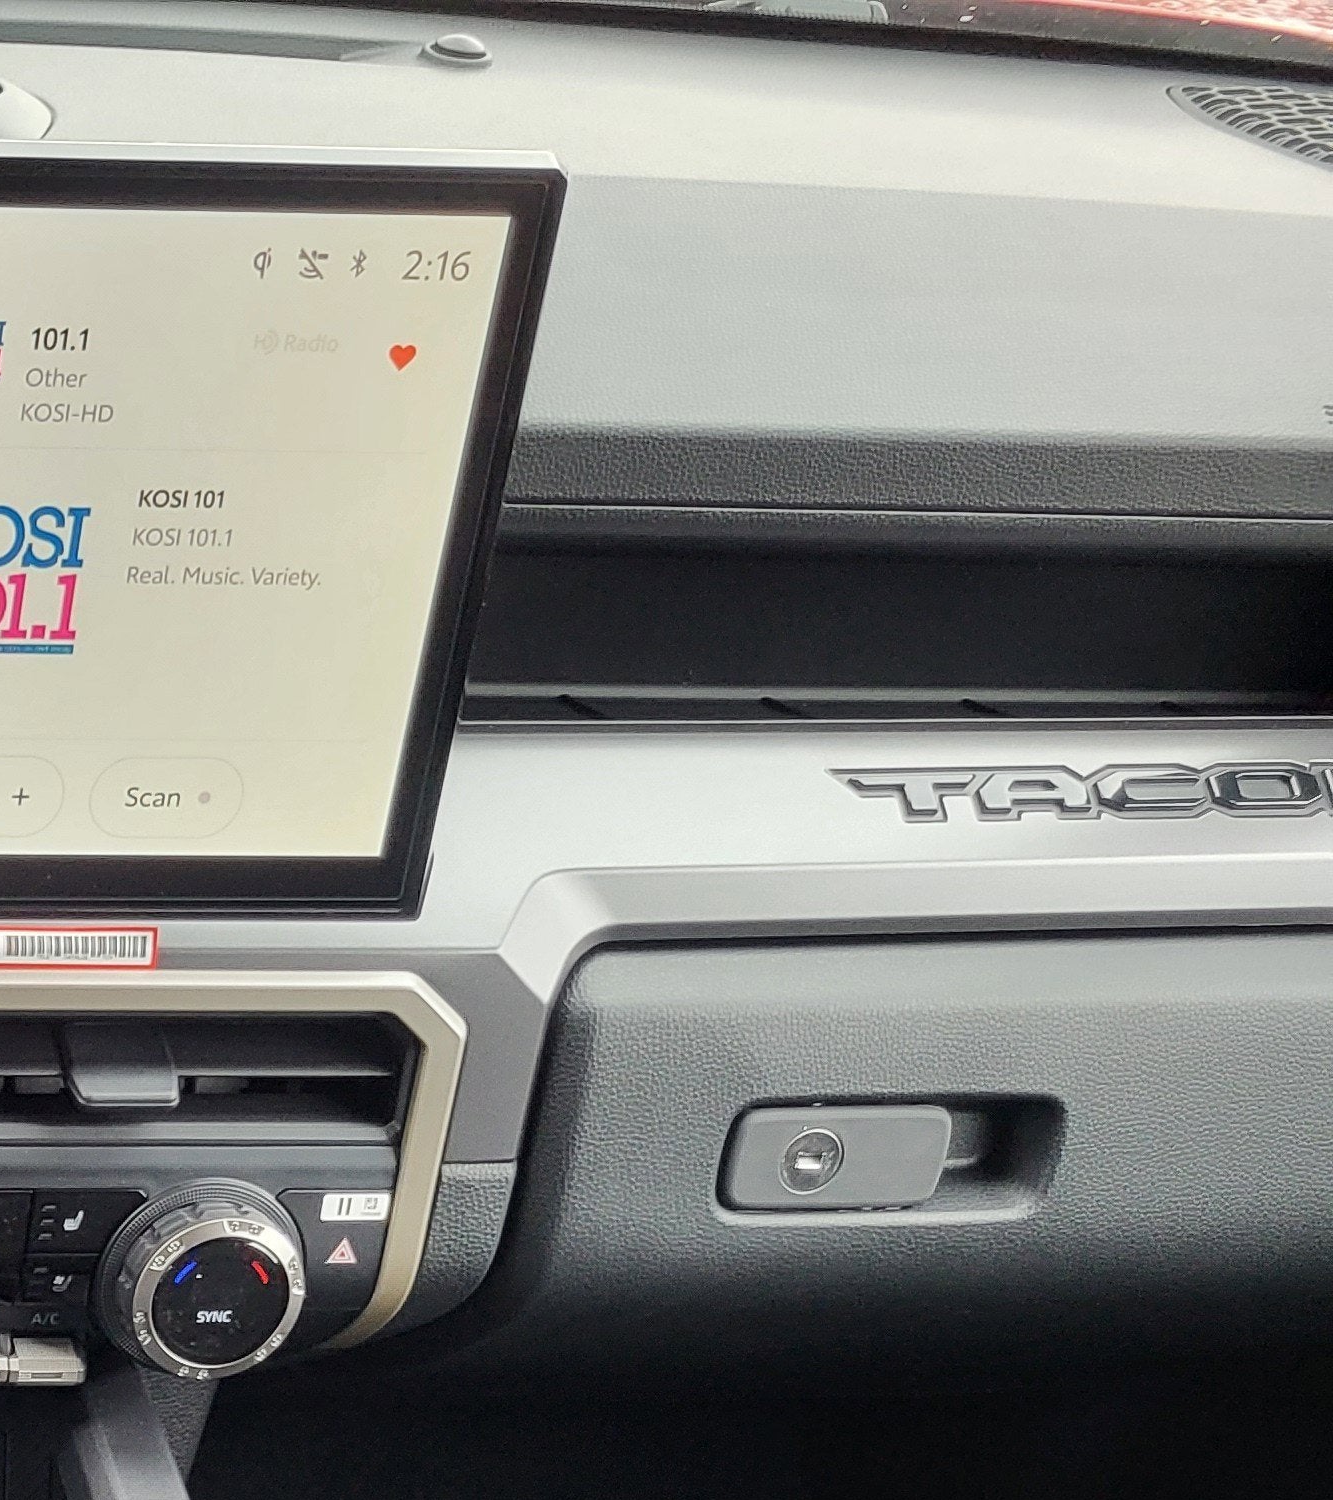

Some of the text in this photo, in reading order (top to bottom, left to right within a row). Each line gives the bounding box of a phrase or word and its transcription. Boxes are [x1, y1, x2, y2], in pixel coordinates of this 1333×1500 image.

[402, 250, 471, 282] 2:16
[30, 328, 91, 352] 101.1
[283, 334, 339, 352] Radio
[25, 367, 87, 389] Other
[20, 404, 114, 424] KOSI-HD
[138, 489, 226, 509] KOSI 101
[132, 528, 234, 548] KOSI 101.1
[126, 566, 322, 590] Real. Music. Variety.
[124, 787, 181, 809] Scan
[825, 760, 1333, 823] TACO
[31, 1312, 59, 1325] A/C
[196, 1310, 233, 1323] SYNC
